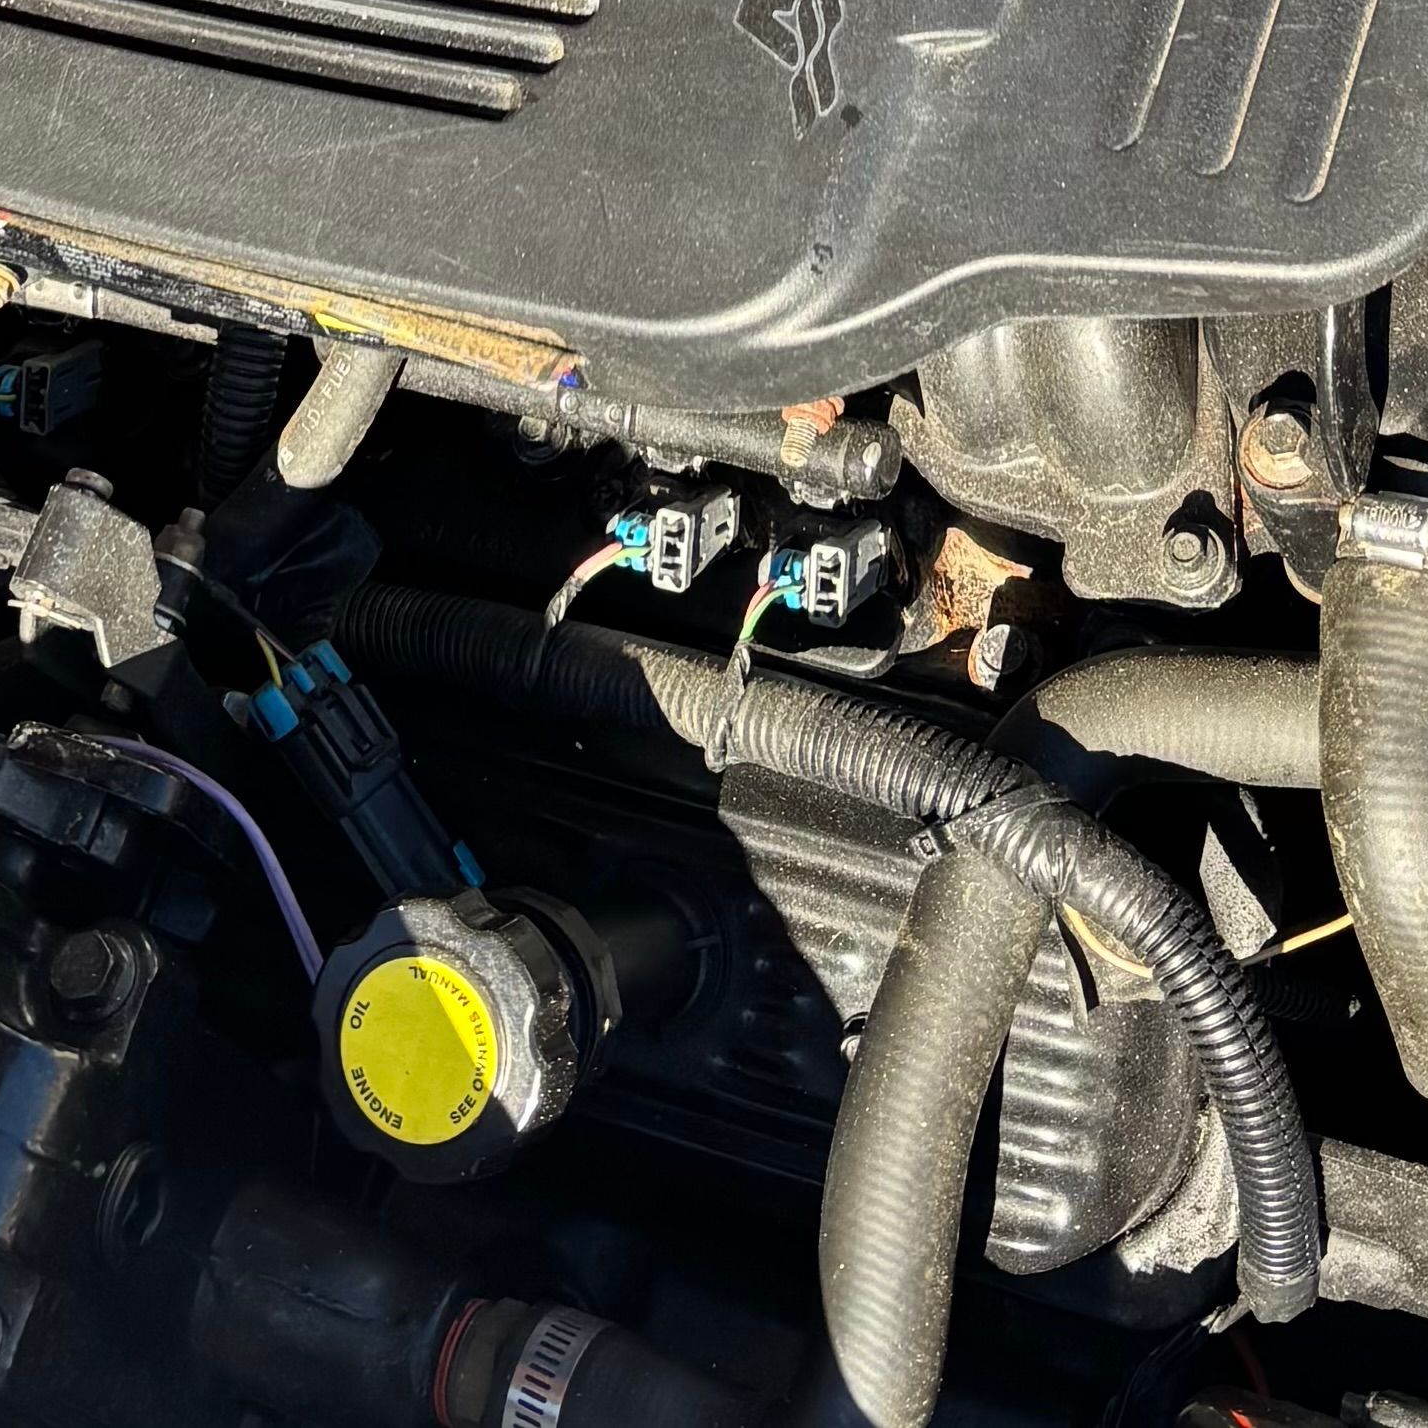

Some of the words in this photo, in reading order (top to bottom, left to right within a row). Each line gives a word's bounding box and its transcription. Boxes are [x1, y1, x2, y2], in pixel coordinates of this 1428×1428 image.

[408, 965, 472, 1008] MANUAL
[349, 999, 371, 1030] OIL
[468, 1010, 490, 1093] OWNERS
[351, 1065, 404, 1130] ENGINE
[449, 1094, 476, 1125] SEE
